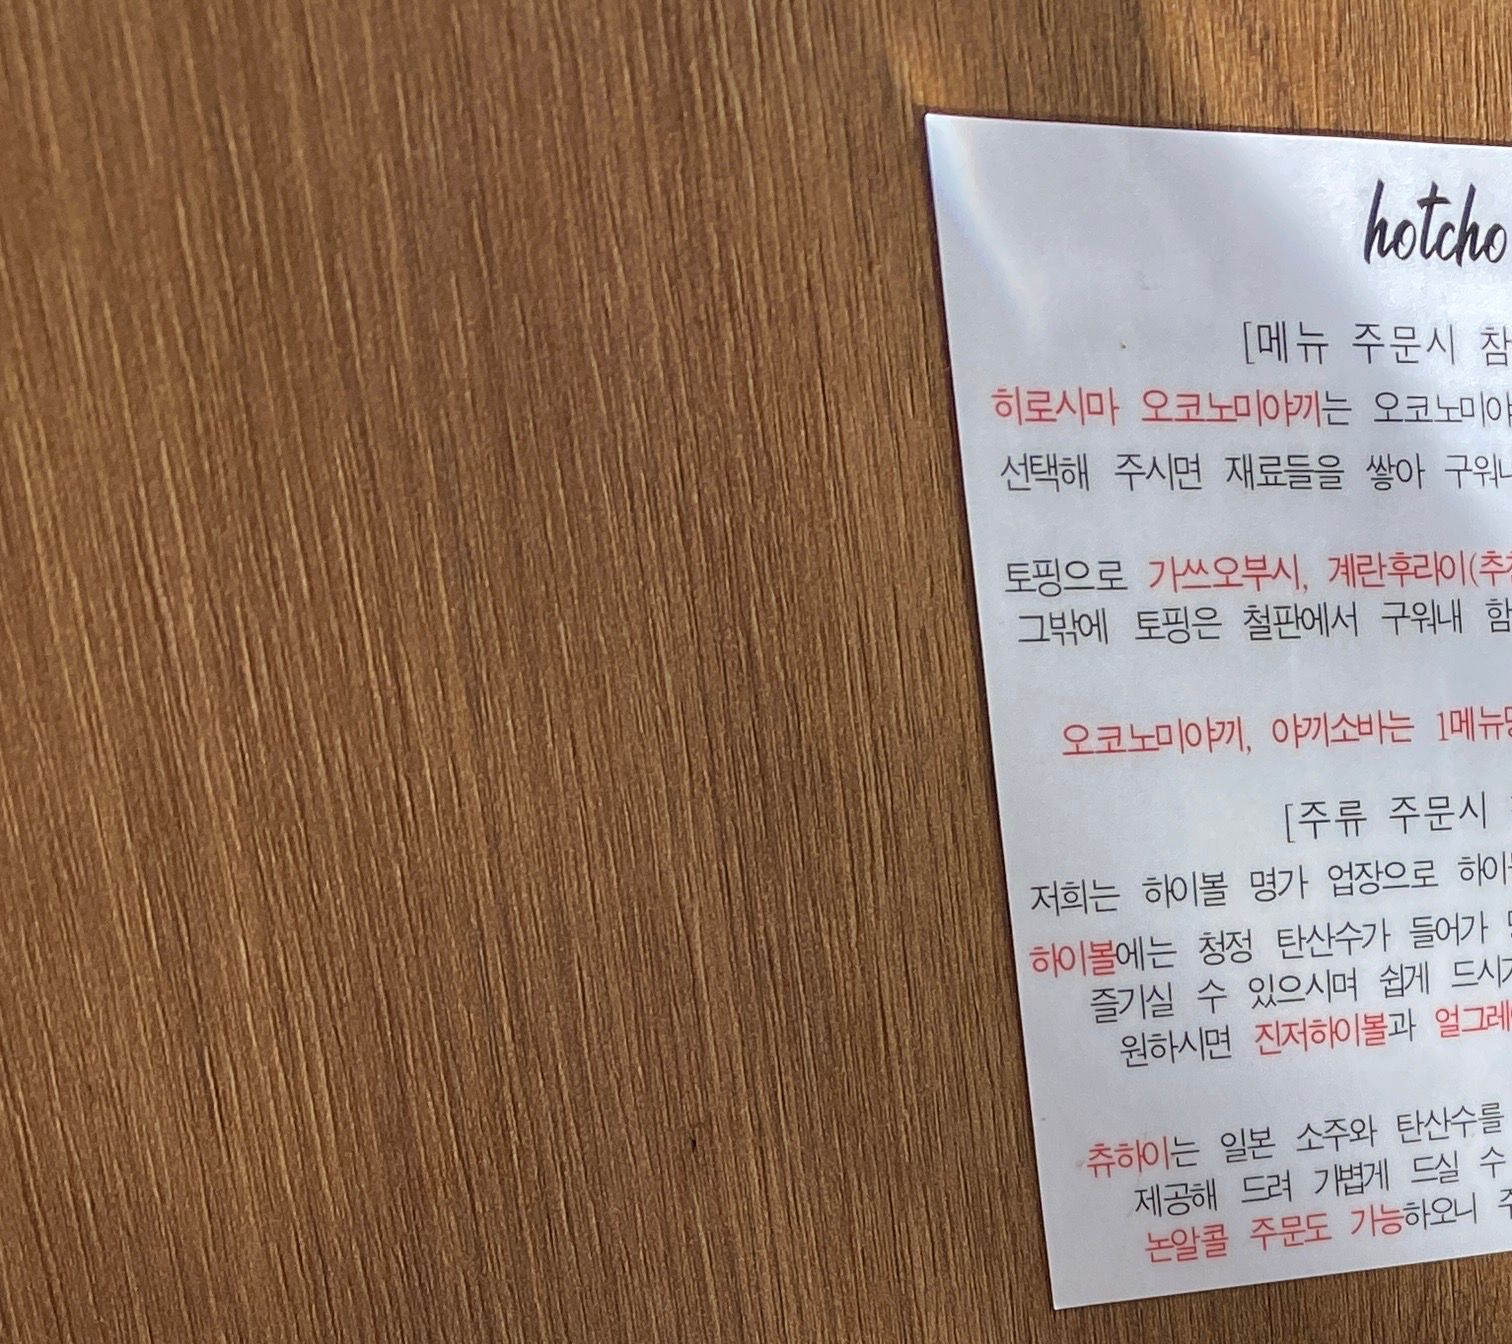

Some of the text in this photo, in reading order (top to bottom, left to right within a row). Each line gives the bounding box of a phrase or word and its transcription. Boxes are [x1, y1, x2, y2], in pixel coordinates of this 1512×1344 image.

[1364, 178, 1507, 267] hotcho
[1243, 321, 1328, 364] [메뉴
[1352, 323, 1454, 364] 주문시
[992, 386, 1119, 426] 히로시마
[1142, 389, 1352, 427] 오코노미야끼는
[1001, 453, 1089, 492] 선택해
[1115, 453, 1202, 491] 주시면
[1225, 453, 1344, 490] 재료들을
[1366, 453, 1425, 490] 쌓아
[1005, 558, 1128, 597] 토핑으로
[1149, 553, 1307, 593] 가쓰오부시,
[1018, 608, 1108, 646] 그밖에
[1135, 606, 1222, 644] 토핑은
[1243, 601, 1357, 640] 철판에서
[1382, 598, 1462, 635] 구워내
[1063, 716, 1251, 755] 오코노미야끼,
[1272, 710, 1414, 748] 야끼소바는
[1285, 800, 1367, 843] [주류
[1389, 791, 1486, 834] 주문시
[1031, 879, 1120, 916] 저희는
[1142, 871, 1228, 908] 하이볼
[1250, 865, 1308, 901] 명가
[1328, 860, 1438, 897] 업장으로
[1120, 1024, 1231, 1067] 원하시면
[1255, 1008, 1416, 1055] 진저하이볼과
[1087, 1136, 1199, 1177] 츄하이는
[1221, 1126, 1275, 1163] 일본
[1296, 1114, 1377, 1151] 소주와
[1397, 1102, 1504, 1143] 탄산수를
